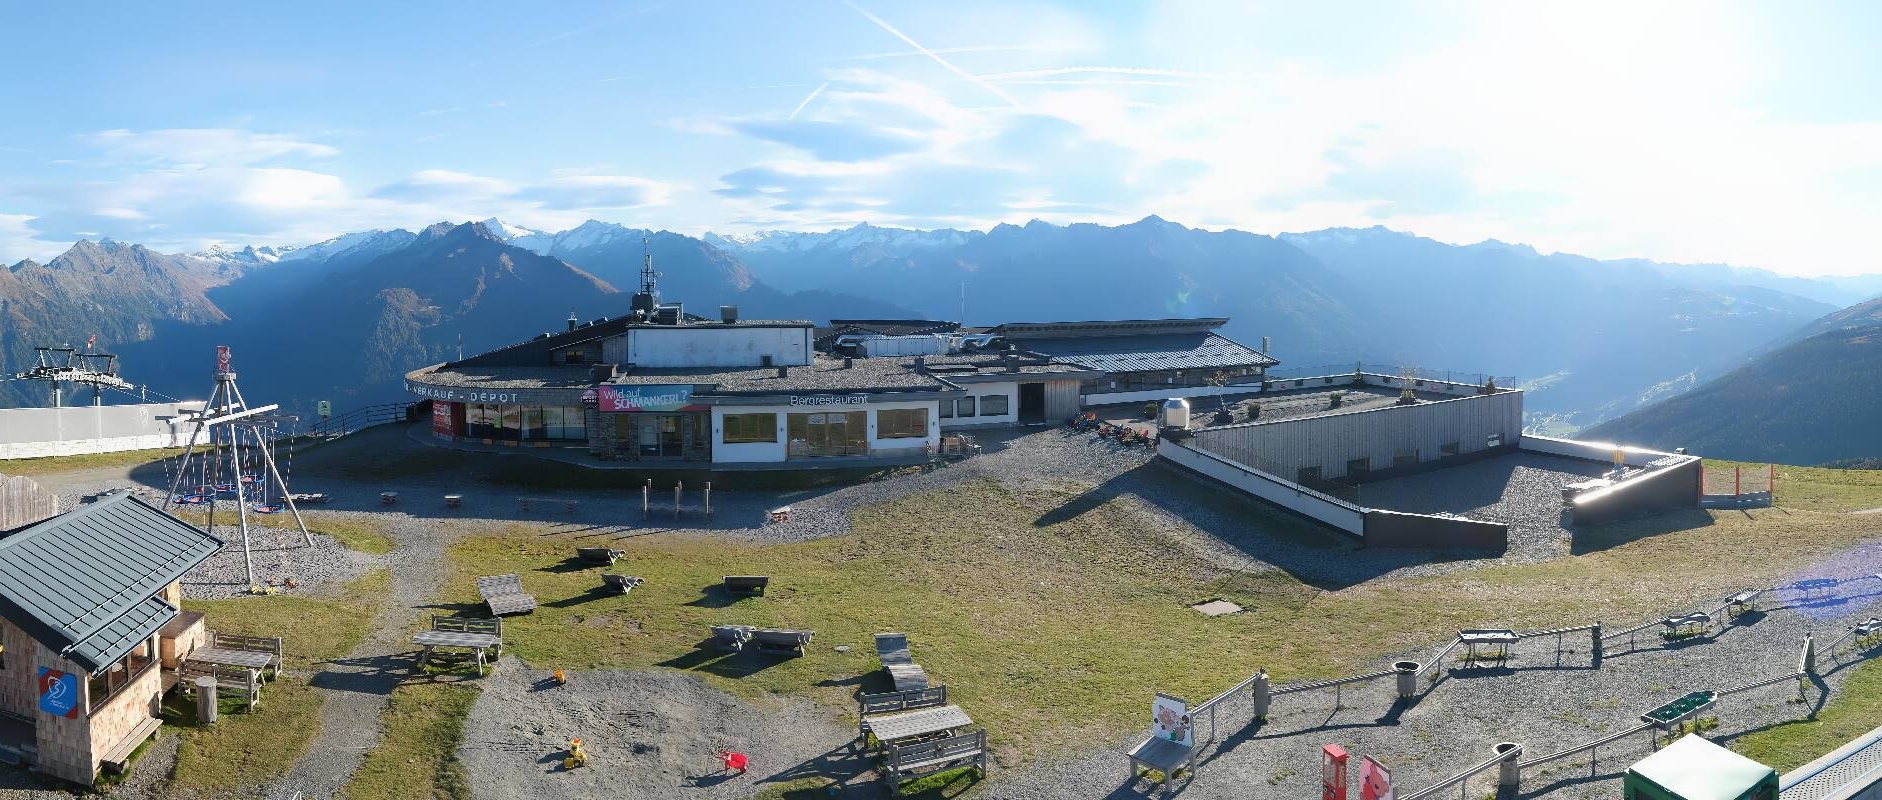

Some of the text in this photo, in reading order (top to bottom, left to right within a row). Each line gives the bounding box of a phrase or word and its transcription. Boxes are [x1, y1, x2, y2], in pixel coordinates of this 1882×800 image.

[413, 386, 454, 400] VERKAUF
[470, 392, 518, 403] DEPOT
[603, 388, 624, 400] Wild
[626, 386, 641, 398] auf
[790, 394, 868, 406] Bergrestaurant
